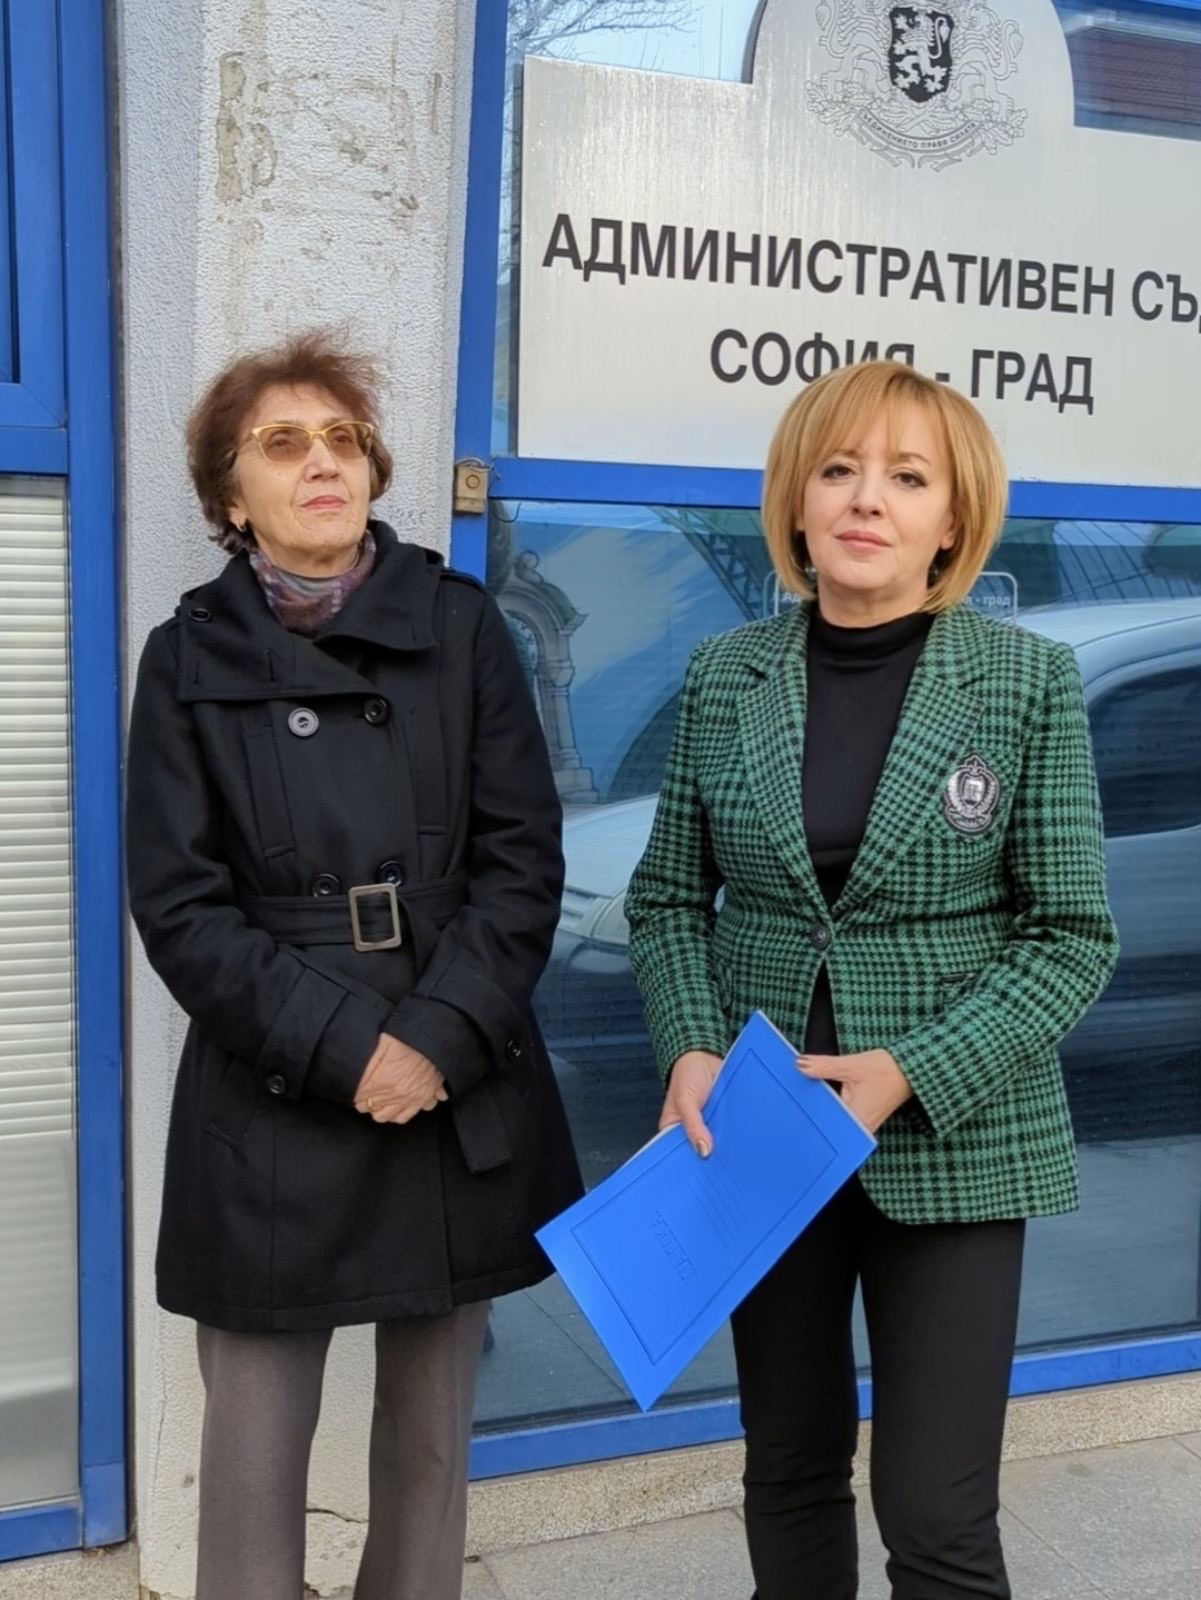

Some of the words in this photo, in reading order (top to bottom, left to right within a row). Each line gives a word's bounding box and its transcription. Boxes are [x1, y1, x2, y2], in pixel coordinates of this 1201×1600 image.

[542, 213, 1114, 317] АДМИНИСТРАТИВЕН
[1132, 270, 1201, 334] СЪ
[935, 372, 950, 382] -
[971, 348, 1094, 415] ГРАД
[983, 595, 1011, 609] град
